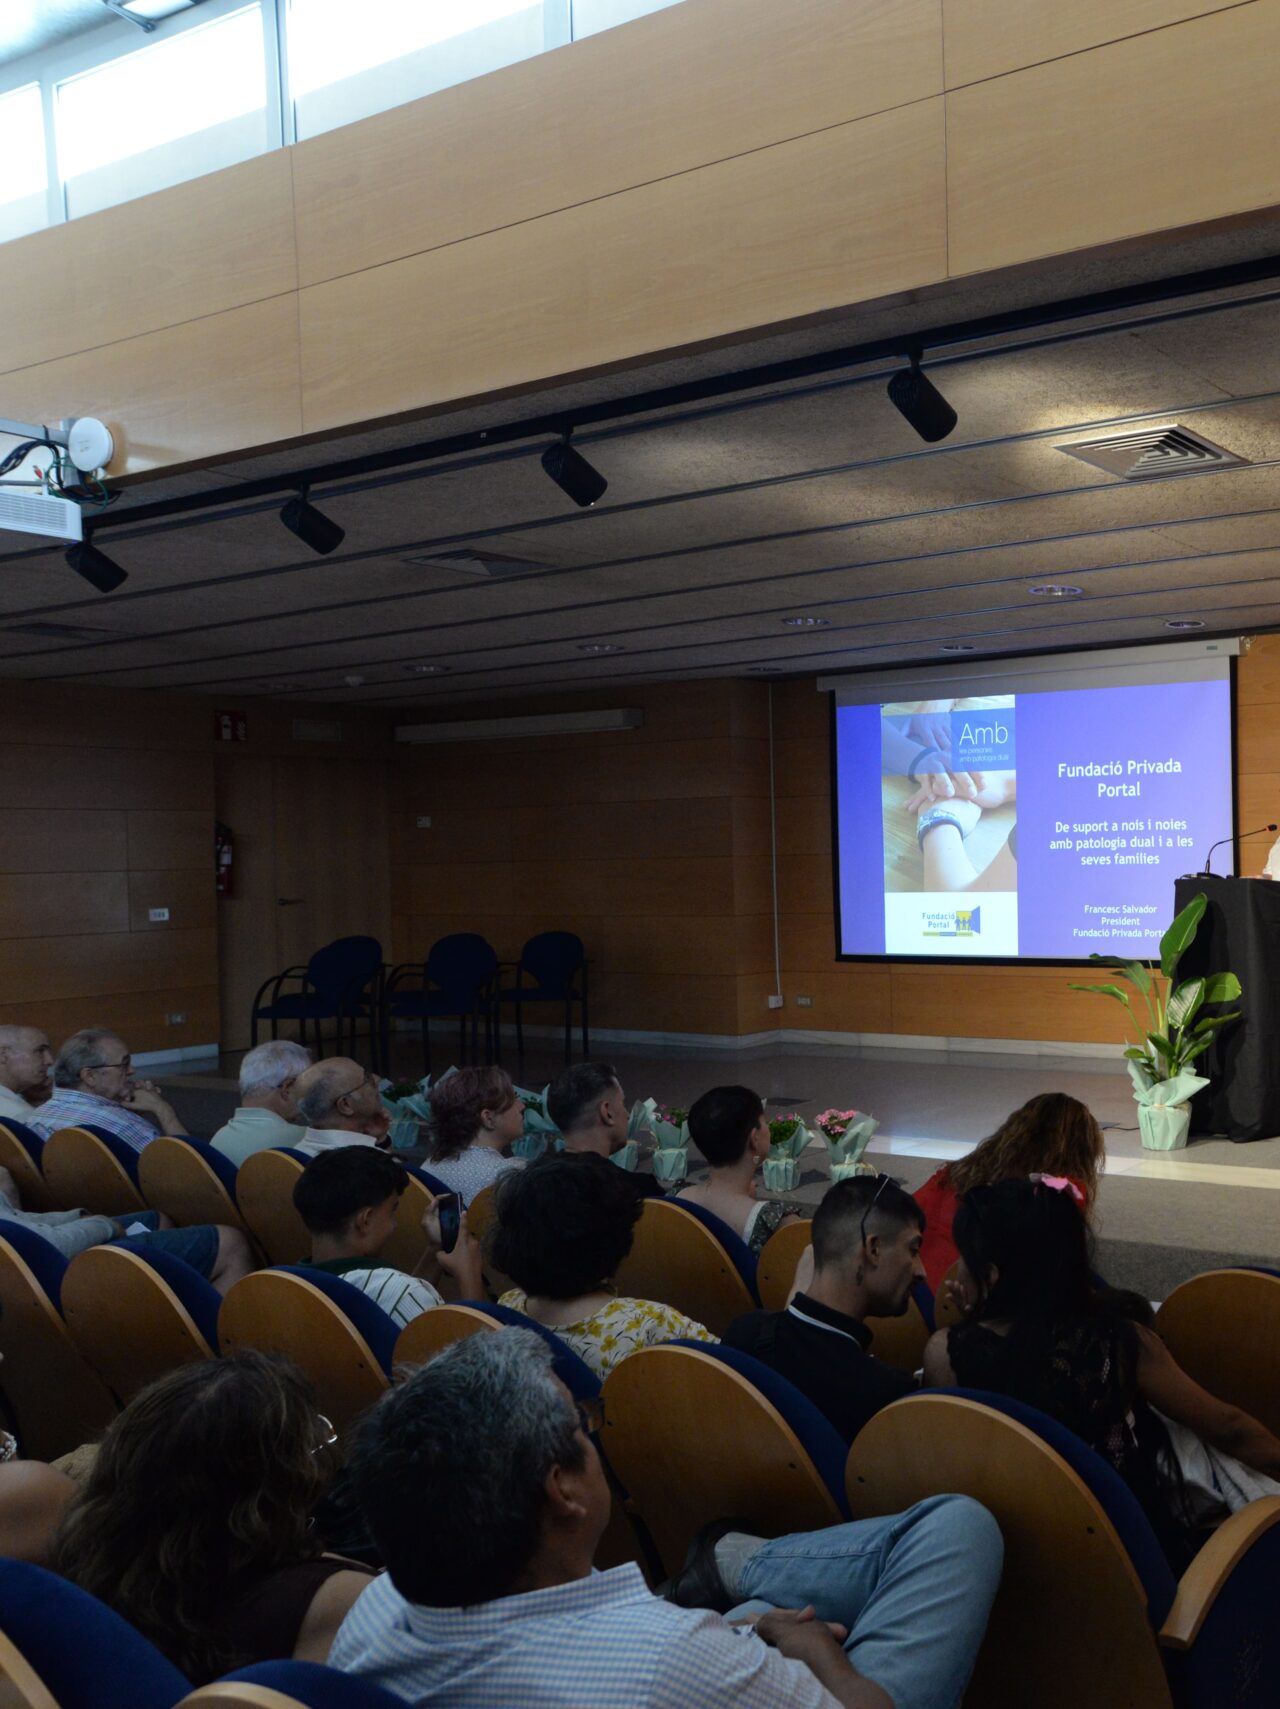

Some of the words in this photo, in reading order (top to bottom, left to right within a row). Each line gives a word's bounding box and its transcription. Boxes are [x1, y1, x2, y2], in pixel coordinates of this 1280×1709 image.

[959, 720, 1008, 745] Amb
[1058, 760, 1122, 777] Fundació
[1127, 758, 1182, 775] Privada
[1098, 782, 1140, 797] Portal
[1055, 822, 1069, 833] De
[1073, 821, 1108, 834] suport
[1112, 823, 1118, 831] a
[1122, 819, 1144, 831] nois
[1156, 819, 1187, 830] noies
[1050, 838, 1072, 849] amb
[1076, 836, 1126, 851] patologia
[1130, 836, 1154, 848] dual
[1166, 838, 1173, 847] a
[1177, 835, 1193, 847] les
[1081, 855, 1111, 865] seves
[1084, 904, 1120, 914] Francesc
[1122, 904, 1158, 914] Salvador
[1101, 917, 1140, 926] President
[1073, 928, 1110, 937] Fundació
[1112, 928, 1142, 937] Privada
[1144, 928, 1168, 938] Porta
